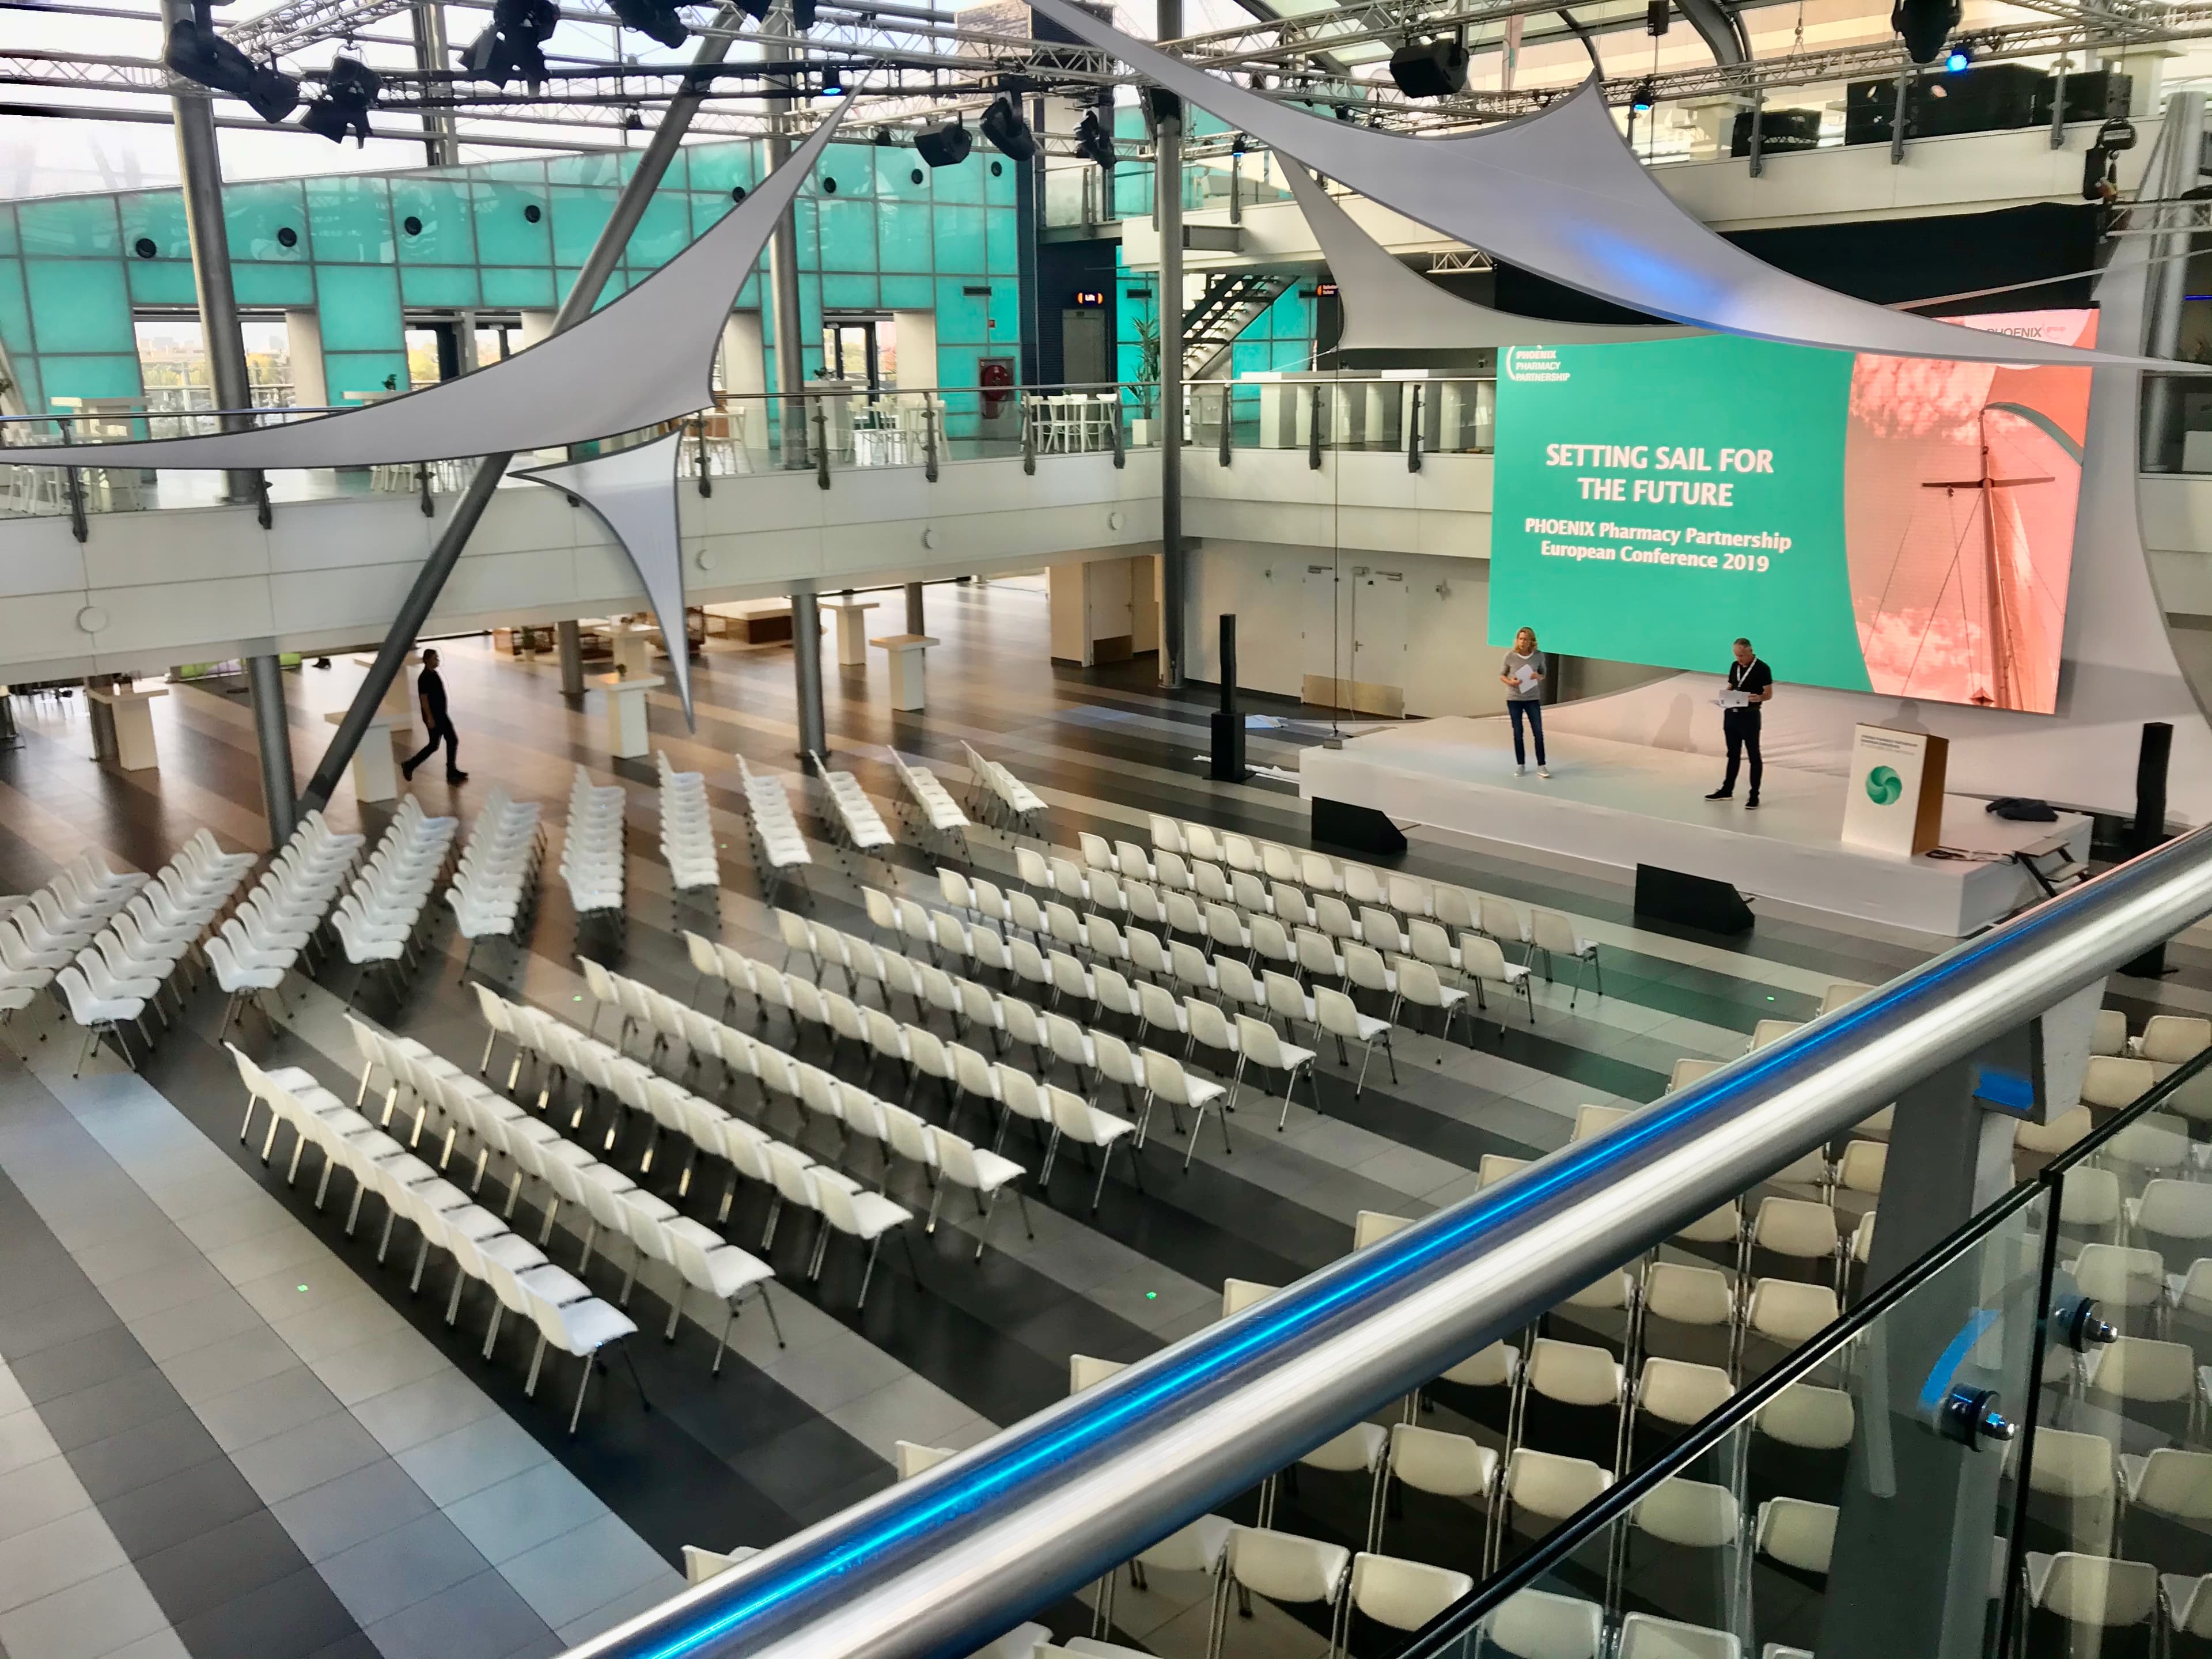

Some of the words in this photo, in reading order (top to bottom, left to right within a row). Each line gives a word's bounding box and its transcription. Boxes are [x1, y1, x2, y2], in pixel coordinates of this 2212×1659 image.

[1516, 350, 1556, 359] PHOENIX
[1516, 362, 1561, 370] PHARMACY
[1515, 373, 1571, 381] PARTNERSHIP
[1546, 444, 1648, 469] SETTING
[1655, 446, 1711, 471] SAIL
[1719, 448, 1774, 474] FOR
[1577, 478, 1626, 501] THE
[1633, 480, 1734, 507] FUTURE
[1525, 518, 1595, 536] PHOENIX
[1599, 522, 1681, 546] Pharmacy
[1685, 528, 1792, 553] Partnership
[1541, 540, 1616, 561] European
[1620, 546, 1718, 568] Conference
[1722, 553, 1770, 572] 2019
